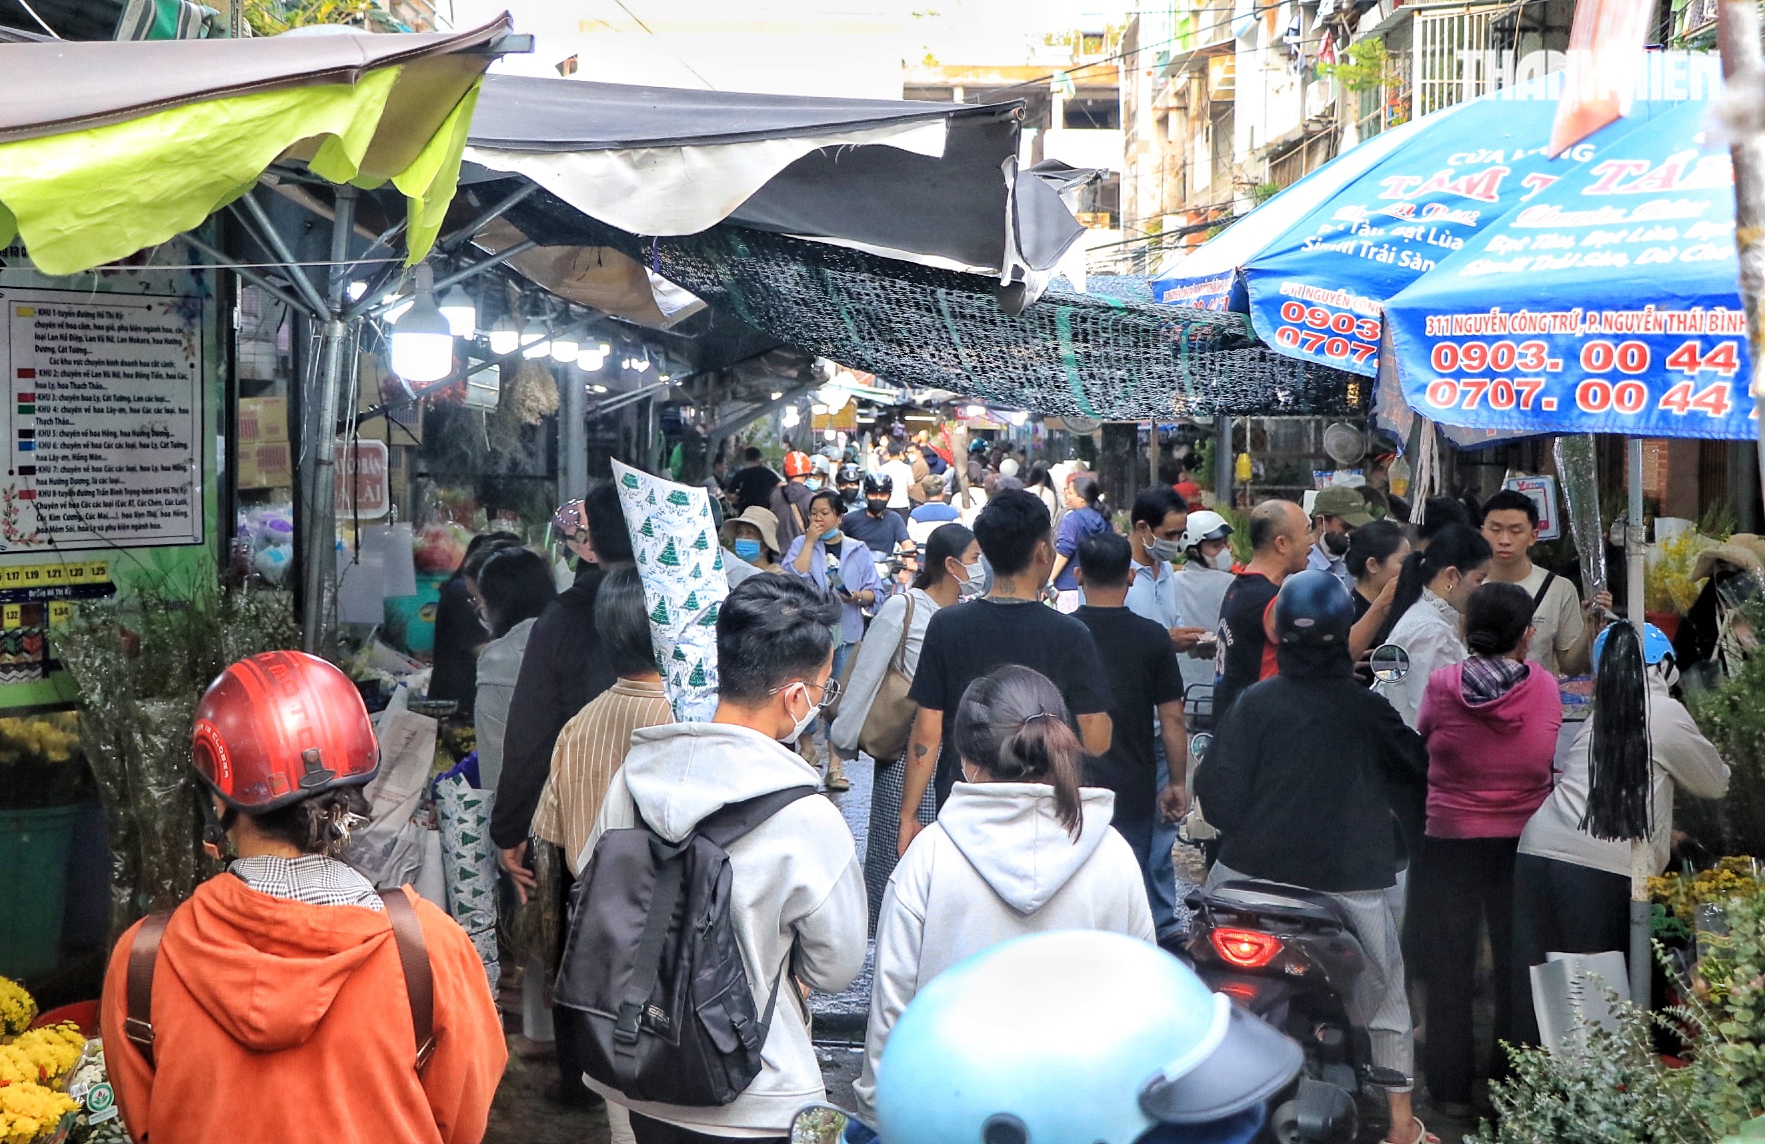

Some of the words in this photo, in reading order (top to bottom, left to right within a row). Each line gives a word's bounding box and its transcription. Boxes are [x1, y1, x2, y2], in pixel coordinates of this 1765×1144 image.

[1358, 240, 1395, 264] Trải
[1304, 285, 1350, 309] NGUYỄN
[65, 321, 76, 330] hoa
[93, 322, 103, 331] hoa
[1426, 314, 1450, 336] 311
[1453, 307, 1508, 335] NGUYỄN
[1510, 309, 1548, 335] CÔNG
[1550, 308, 1583, 338] TRỨ,
[1586, 313, 1600, 334] P.
[1602, 304, 1664, 334] NGUYỄN
[1666, 307, 1705, 335] THÁI
[47, 332, 58, 341] Lan
[85, 334, 95, 342] Lan
[152, 336, 163, 344] hoa
[1431, 340, 1563, 373] 0903.
[1580, 340, 1648, 374] 00
[1665, 340, 1740, 377] 44
[1425, 378, 1557, 411] 0707.
[1576, 378, 1648, 414] 00
[1659, 380, 1731, 418] 44
[93, 405, 103, 413] hoa
[129, 406, 139, 414] hoa
[178, 406, 188, 414] hoa
[89, 429, 100, 437] hoa
[119, 429, 130, 437] hoa
[91, 441, 101, 449] hoa
[6, 571, 20, 580] 1.17
[25, 571, 39, 579] 1.19
[47, 569, 62, 578] 1.21
[69, 568, 84, 577] 1.23
[91, 567, 106, 576] 1.25
